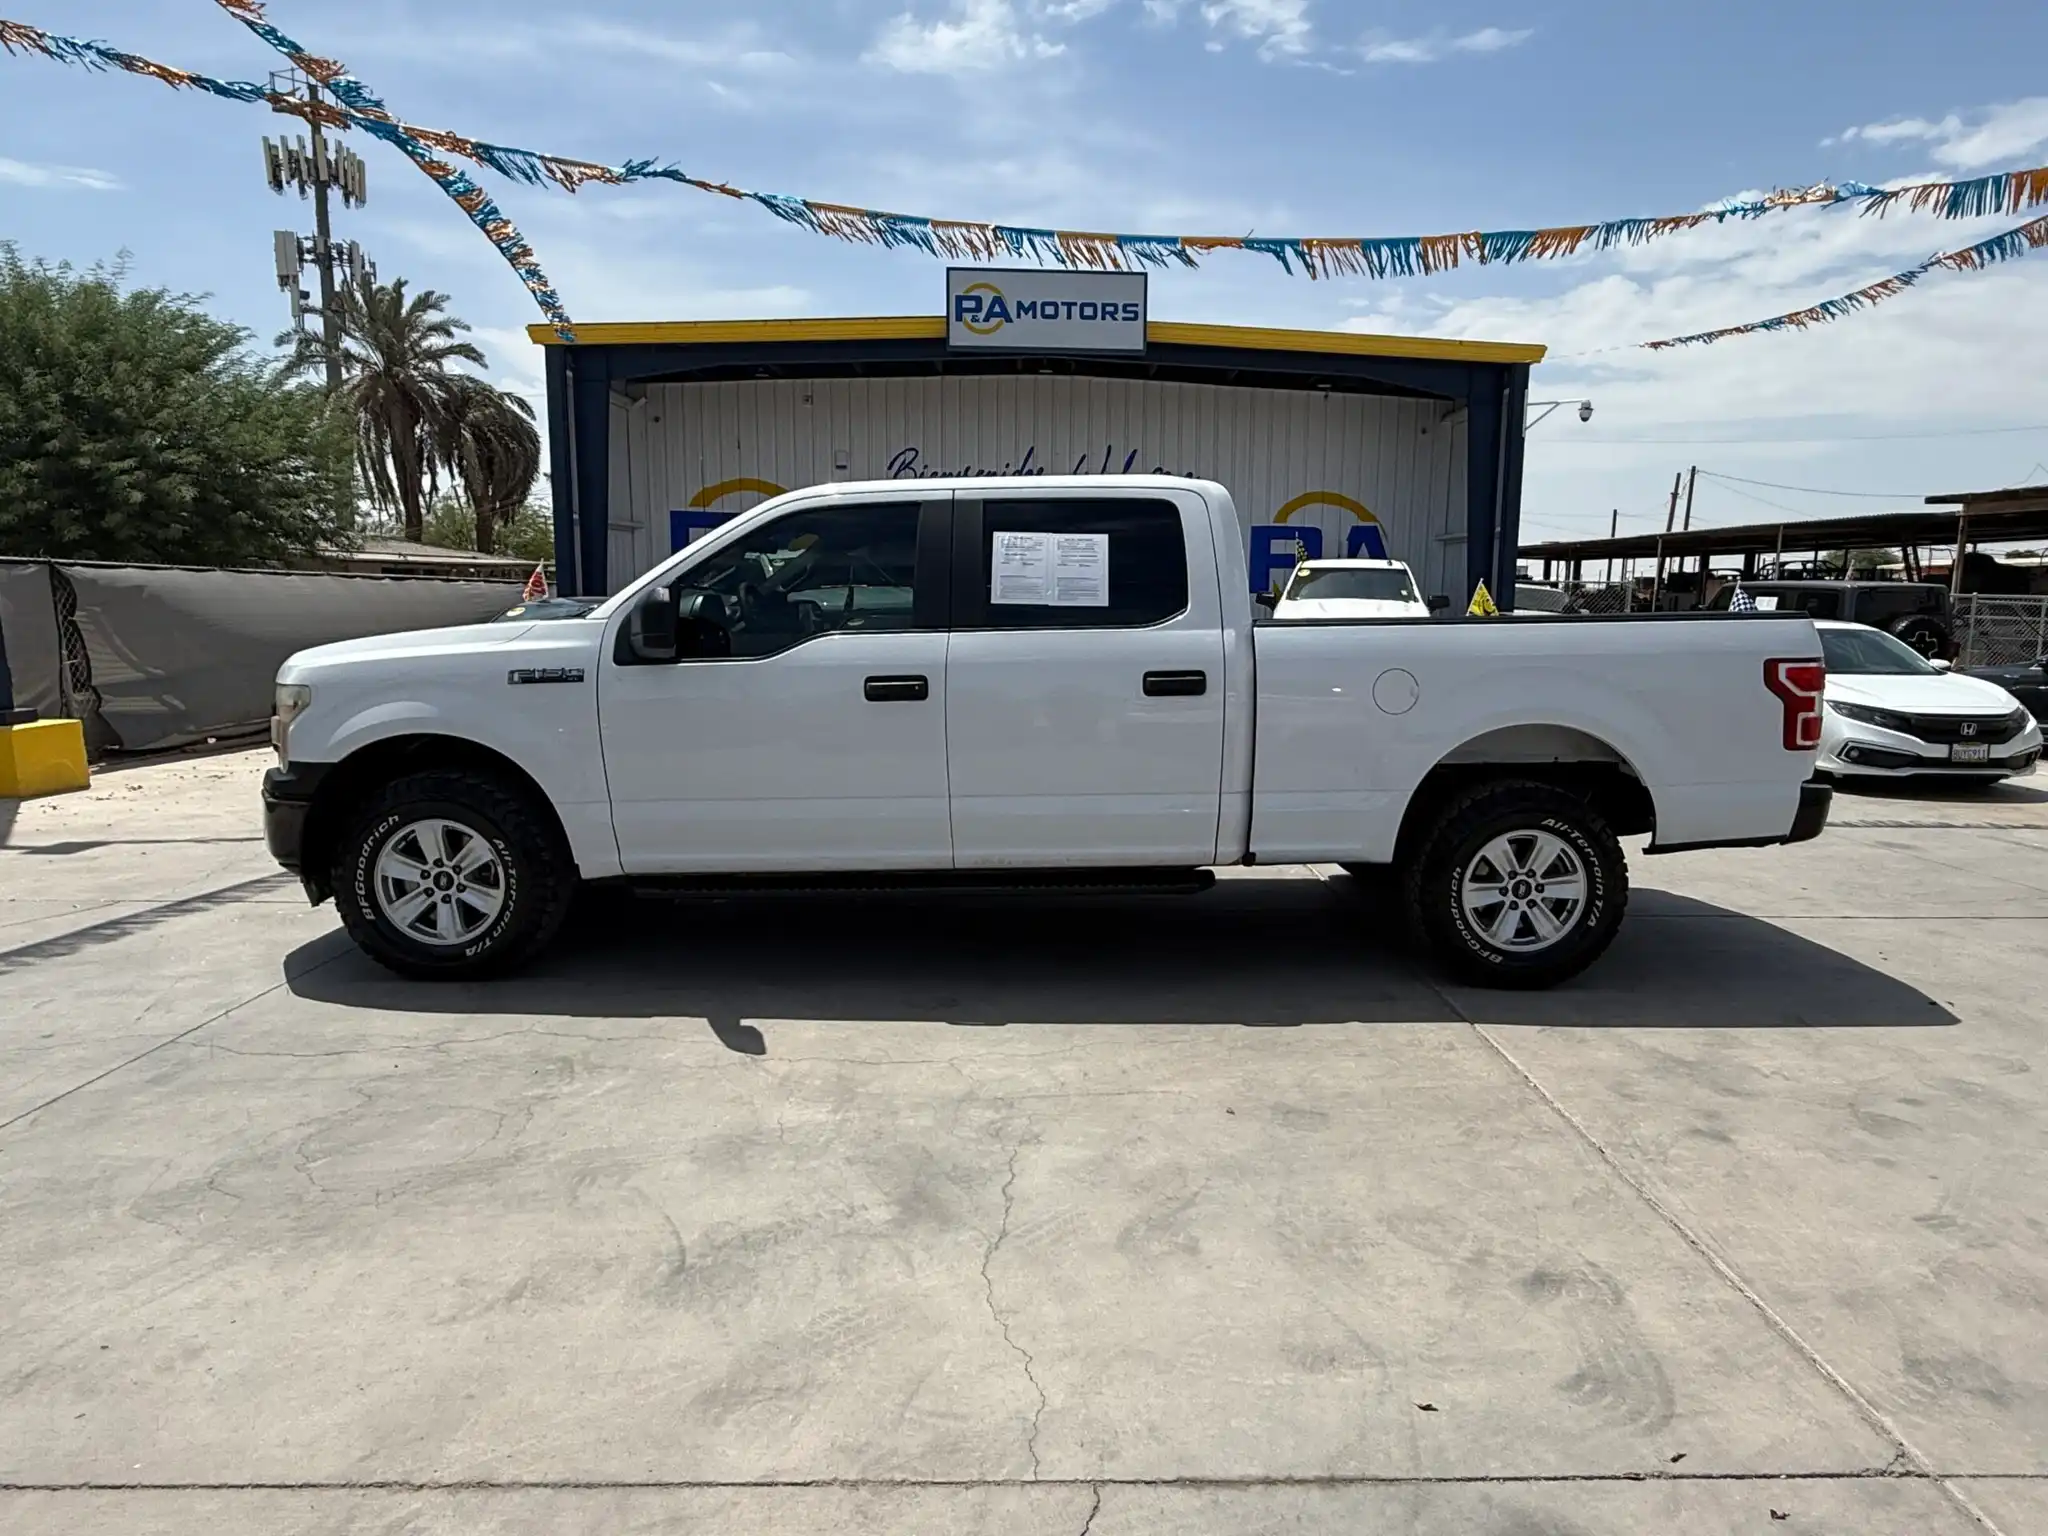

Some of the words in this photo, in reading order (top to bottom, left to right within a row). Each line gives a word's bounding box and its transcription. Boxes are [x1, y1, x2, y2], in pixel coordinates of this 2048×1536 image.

[1016, 300, 1139, 322] MOTORS
[354, 814, 400, 921] BFGoodrich
[491, 837, 517, 939] All-Terrain
[1449, 866, 1504, 964] BFGoodrich
[1541, 818, 1605, 896] All-Terrain
[1587, 898, 1604, 928] T/A
[465, 939, 493, 957] T/A
